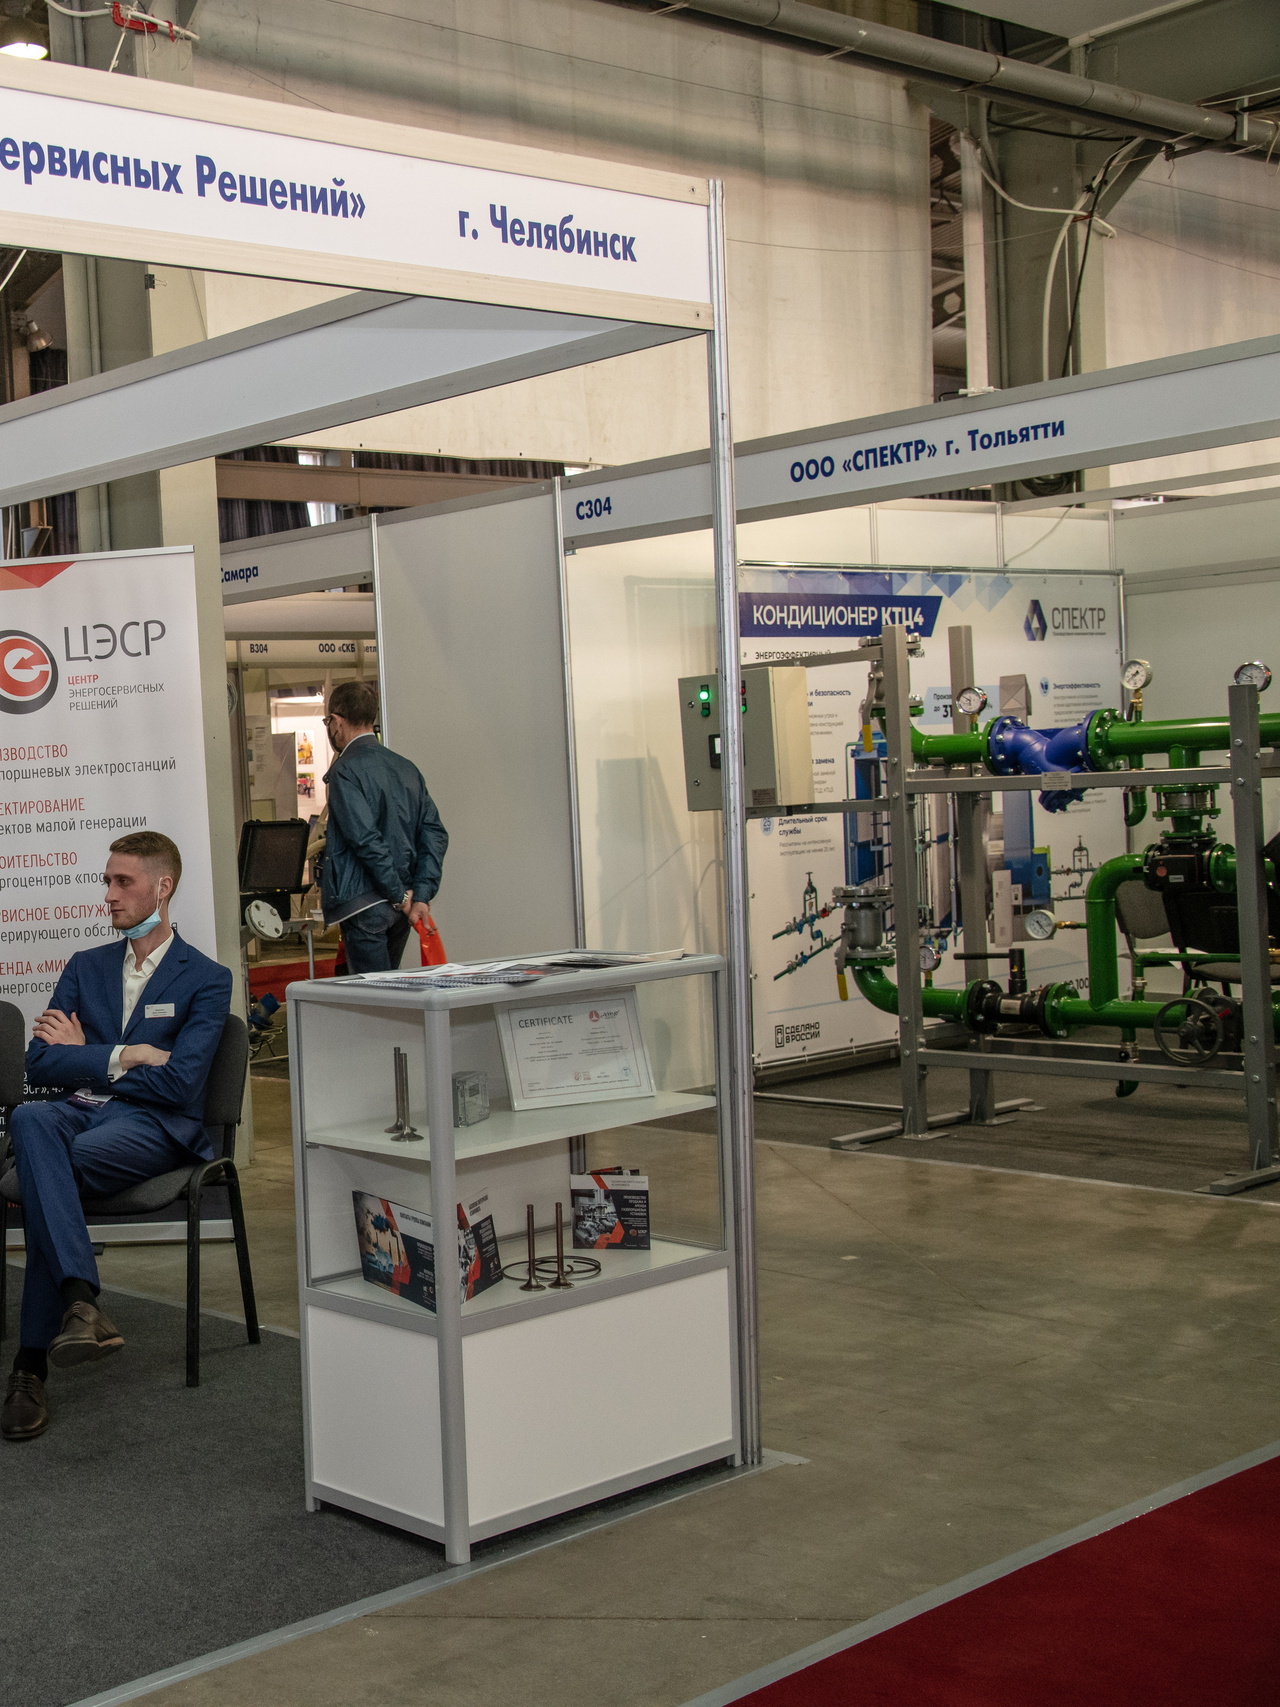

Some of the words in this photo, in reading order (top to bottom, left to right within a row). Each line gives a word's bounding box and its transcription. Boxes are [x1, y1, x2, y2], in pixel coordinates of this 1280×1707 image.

[197, 156, 366, 222] Решений»
[459, 208, 480, 240] г.
[490, 204, 637, 264] Челябинск
[789, 456, 835, 484] ООО
[842, 439, 938, 473] «СПЕКТР»
[946, 436, 961, 457] г.
[967, 419, 1065, 452] Тольятти
[753, 605, 878, 629] КОНДИЦИОНЕР
[882, 606, 925, 629] КТЦ4
[1052, 607, 1106, 630] СПЕКТР
[64, 620, 167, 662] ЦЭСР
[319, 643, 336, 653] ООО
[67, 674, 99, 686] ЦЕНТР
[69, 683, 164, 699] ЭНЕРГОСЕРВИСНЫХ
[69, 697, 118, 712] РЕШЕНИЙ
[75, 757, 176, 778] электростанций
[36, 818, 76, 834] малой
[80, 816, 147, 832] генерации
[778, 816, 814, 826] Длительный
[815, 816, 828, 824] срок
[779, 827, 801, 837] службы
[518, 1014, 574, 1028] CERTIFICATE
[785, 1022, 820, 1035] СДЕЛАНО
[786, 1036, 790, 1044] В
[791, 1030, 820, 1043] РОССИИ
